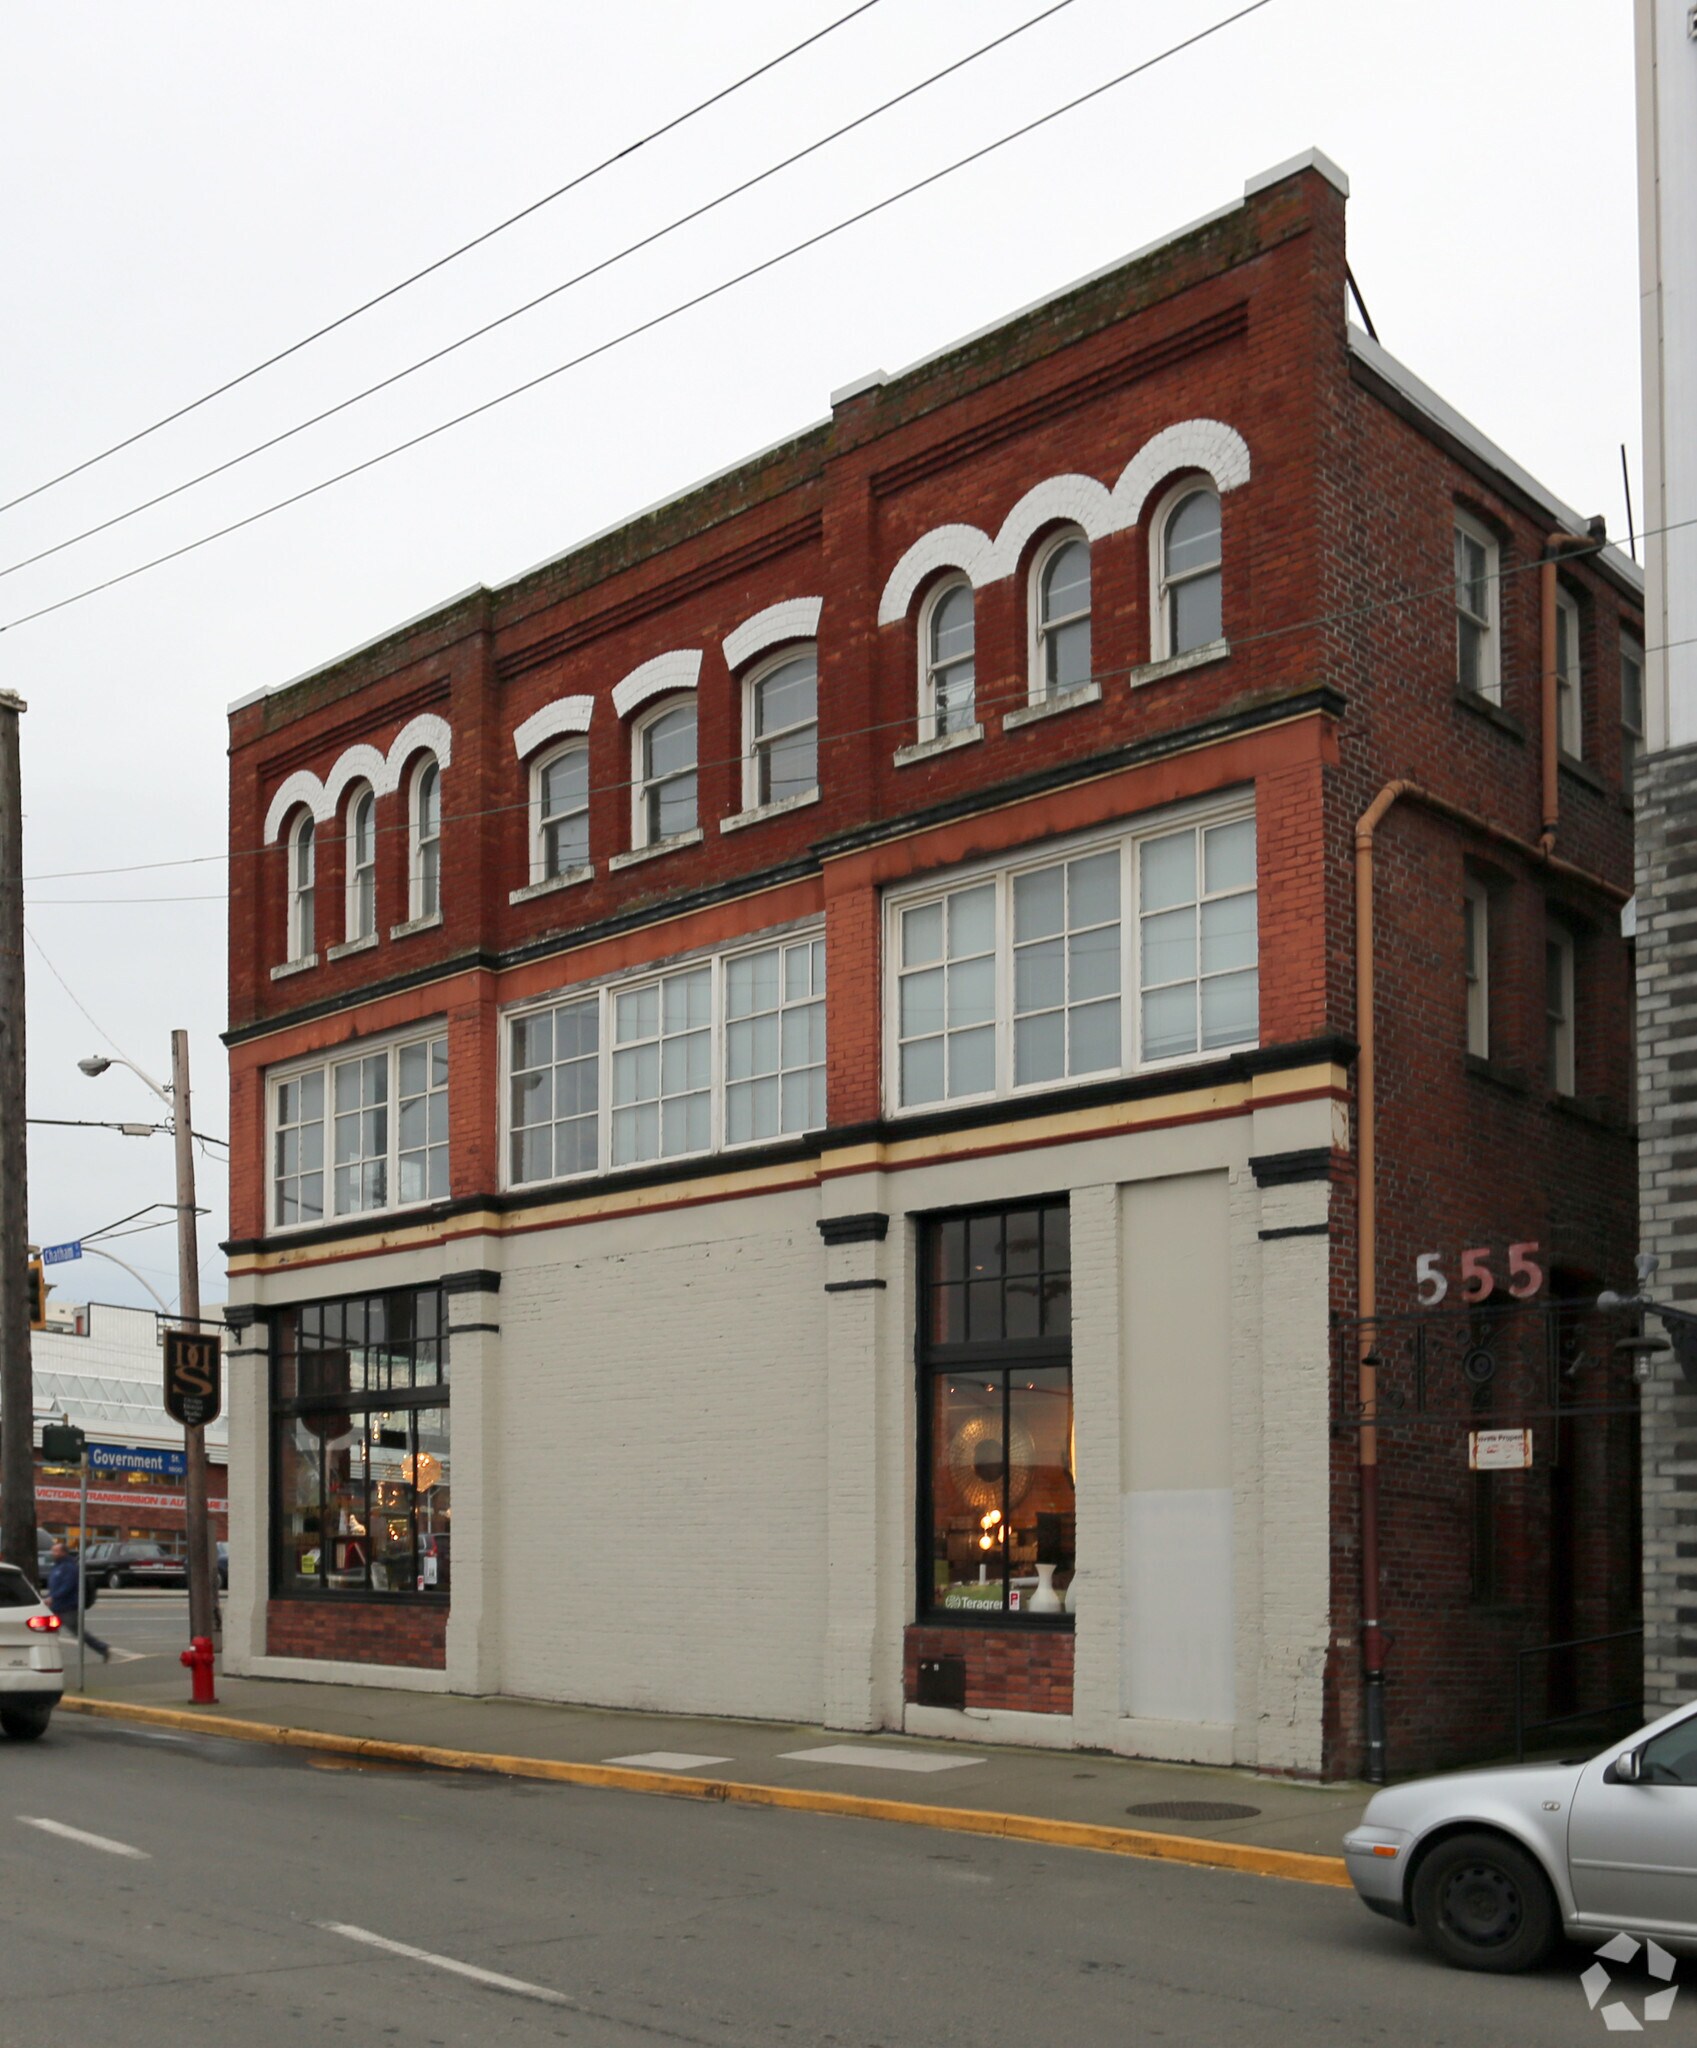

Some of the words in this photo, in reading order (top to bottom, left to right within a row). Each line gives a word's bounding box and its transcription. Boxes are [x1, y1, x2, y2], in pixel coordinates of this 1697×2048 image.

[44, 1246, 73, 1264] Chatham
[1416, 1242, 1543, 1305] 555
[1498, 1433, 1523, 1442] Propert
[93, 1448, 162, 1470] Government
[36, 1488, 81, 1499] VICTORIA
[86, 1491, 158, 1505] TRANSMISSION
